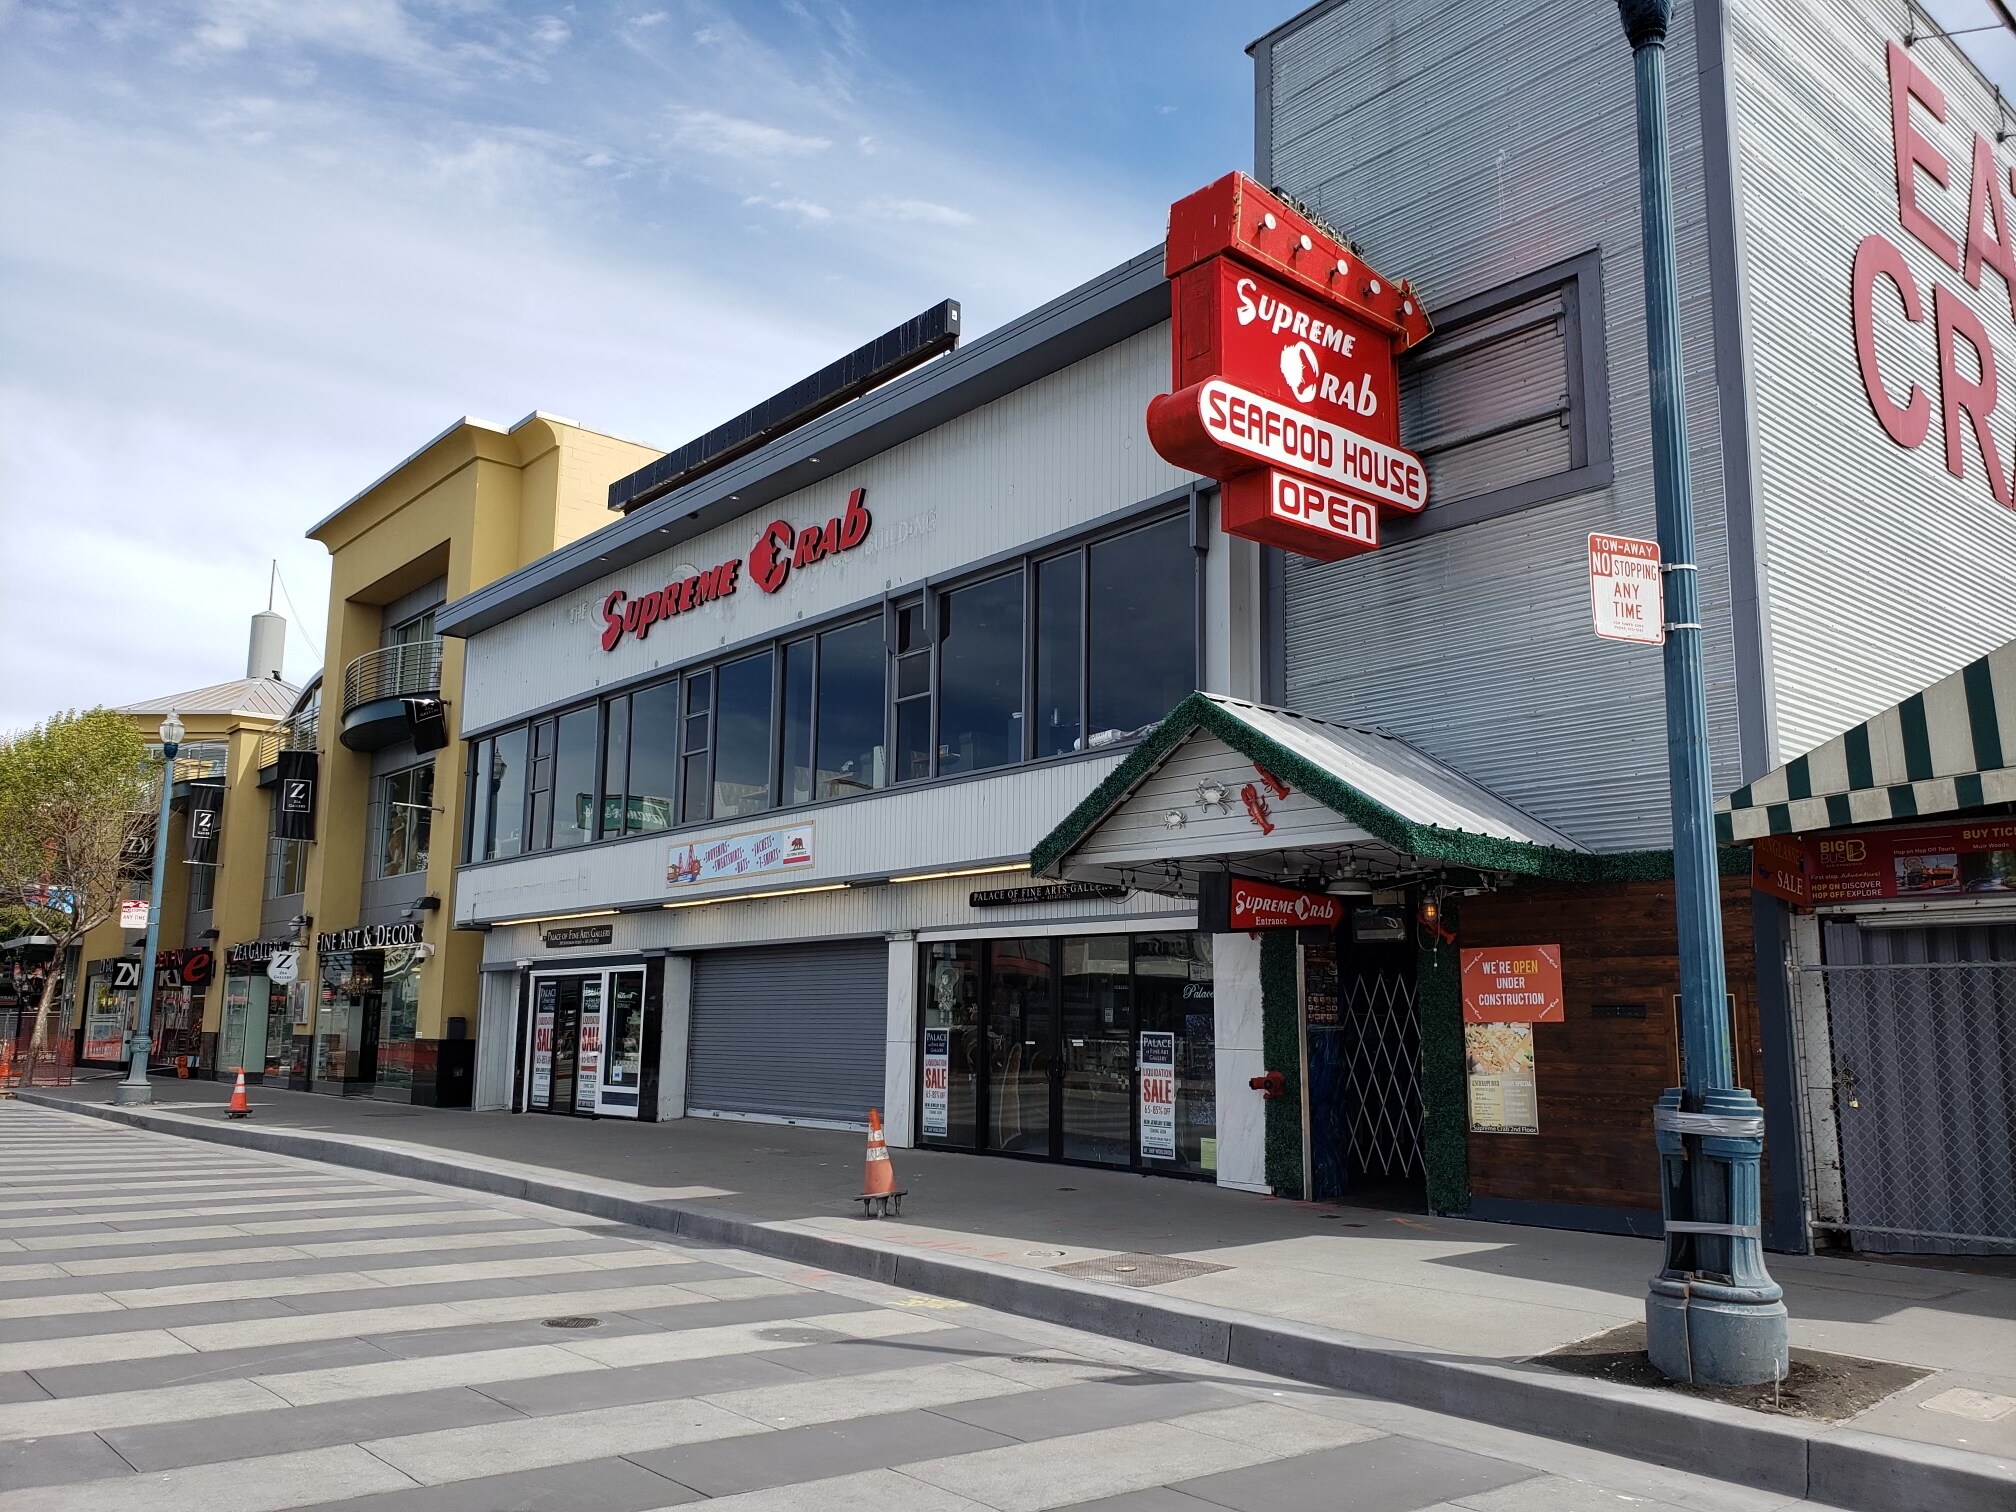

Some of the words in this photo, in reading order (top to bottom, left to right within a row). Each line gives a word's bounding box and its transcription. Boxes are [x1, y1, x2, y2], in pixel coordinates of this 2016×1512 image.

[1887, 40, 2016, 325] EA
[1236, 278, 1356, 358] SUPREME
[1852, 234, 2016, 511] CR
[1209, 389, 1333, 468] SEAFOOD
[1343, 437, 1420, 502] HOUSE
[1279, 479, 1373, 541] OPEN
[1595, 538, 1653, 557] TOW-AWAY
[1592, 552, 1610, 574] NO
[1614, 560, 1657, 580] STOPPING
[1614, 582, 1639, 600] ANY
[602, 559, 742, 652] SUPREME
[1613, 601, 1643, 620] TIME
[289, 782, 306, 799] Z
[198, 812, 212, 827] Z
[1963, 828, 1989, 840] BUY
[705, 841, 728, 863] SOUVENIRS
[754, 835, 772, 856] JACKETS
[1820, 841, 1845, 853] BIG
[714, 847, 743, 872] SWEATSHIRTS
[758, 848, 779, 868] T-SHIRTS
[1820, 853, 1846, 864] BUS
[1777, 870, 1803, 895] SALE
[1841, 880, 1881, 889] DISCOVER
[973, 890, 1005, 902] PALACE
[1007, 889, 1019, 899] OF
[1022, 887, 1042, 898] FINE
[1044, 884, 1067, 895] ARTS
[1846, 889, 1883, 898] EXPLORE
[1235, 890, 1293, 915] SUPREME
[1255, 915, 1288, 926] Entrance
[315, 932, 337, 951] FINE
[340, 929, 360, 949] ART
[363, 926, 371, 947] &
[376, 924, 416, 947] DECOR
[547, 931, 561, 941] PALACE
[568, 930, 580, 940] FINE
[580, 929, 590, 938] ARTS
[591, 927, 611, 938] GALLERY
[233, 944, 247, 961] ZEA
[276, 953, 293, 970] Z
[1482, 960, 1511, 974] WE'RE
[1513, 959, 1538, 974] OPEN
[1183, 983, 1214, 999] Palace
[1496, 977, 1525, 989] UNDER
[1478, 992, 1544, 1006] CONSTRUCTION
[926, 1032, 947, 1042] PALACE
[1143, 1037, 1172, 1048] PALACE
[925, 1068, 947, 1089] SALE
[1142, 1067, 1172, 1078] LIQUIDATION
[1143, 1078, 1172, 1104] SALE
[1144, 1105, 1163, 1116] 65-85%
[1163, 1107, 1171, 1116] OFF
